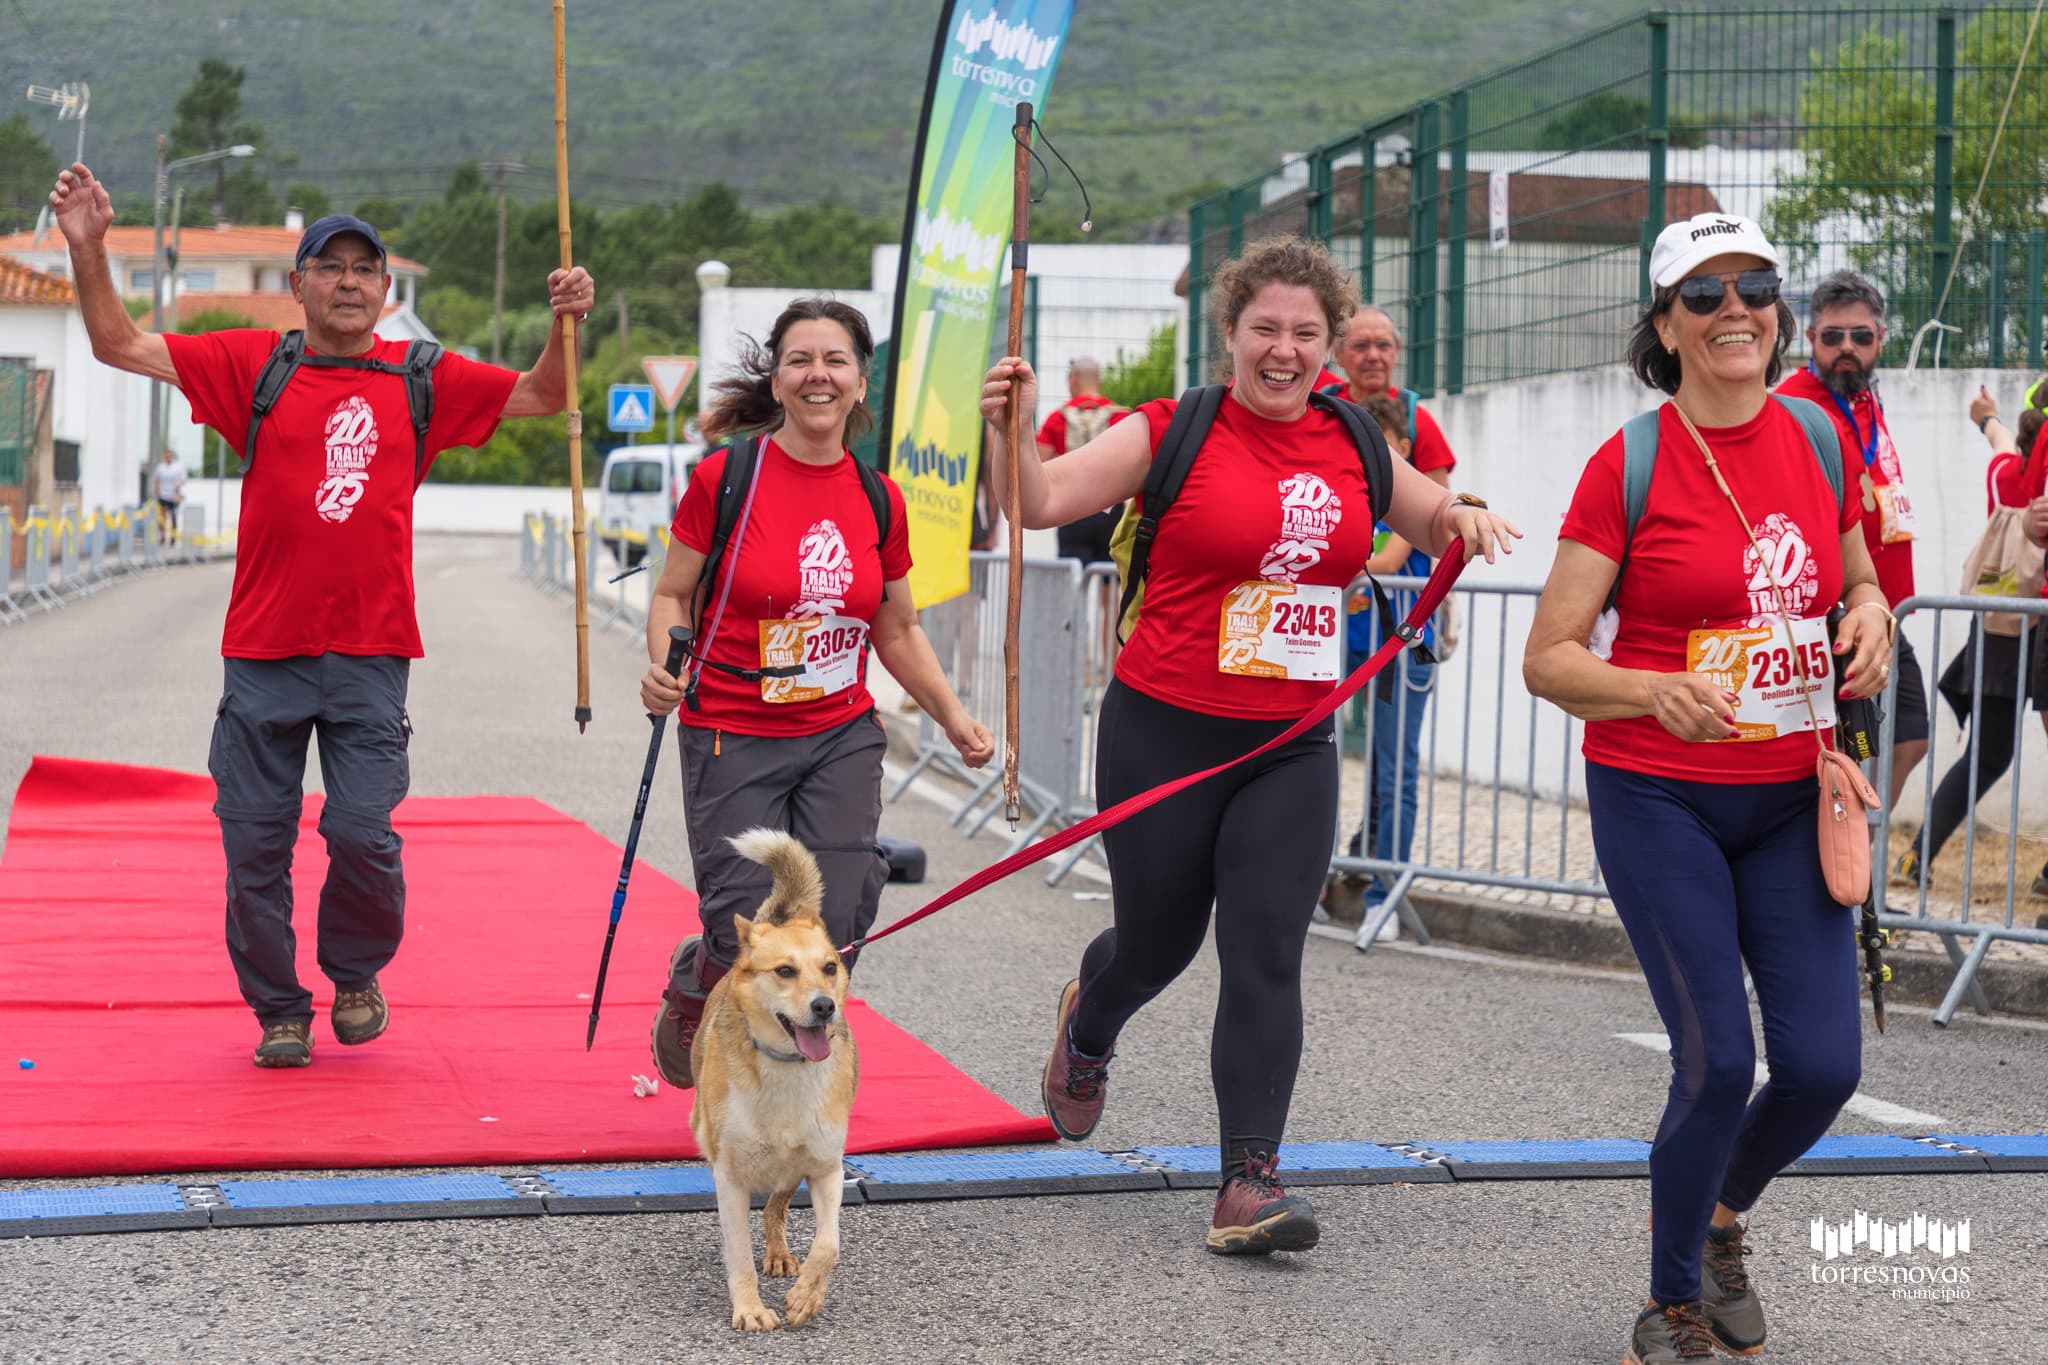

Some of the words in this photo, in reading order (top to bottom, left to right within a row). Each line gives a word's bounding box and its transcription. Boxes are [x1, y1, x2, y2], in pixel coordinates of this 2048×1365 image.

[326, 409, 374, 447] 20
[325, 446, 366, 462] TRAIL
[317, 472, 370, 513] 25
[1282, 480, 1331, 511] 20
[1281, 505, 1328, 530] TRAIL
[800, 534, 846, 571] 20
[1260, 539, 1330, 577] 25
[1747, 530, 1807, 591] 20
[799, 566, 843, 588] TRAIL
[1229, 584, 1269, 615] 20
[1226, 612, 1259, 629] TRAIL
[1273, 602, 1336, 638] 2343
[765, 623, 799, 650] 20
[806, 626, 861, 663] 2303
[765, 648, 795, 662] TRAIL
[1219, 637, 1262, 668] 25
[1694, 636, 1741, 672] 20
[1751, 640, 1829, 690] 2345
[1761, 685, 1795, 701] Deolinda
[1795, 682, 1823, 696] Naciso
